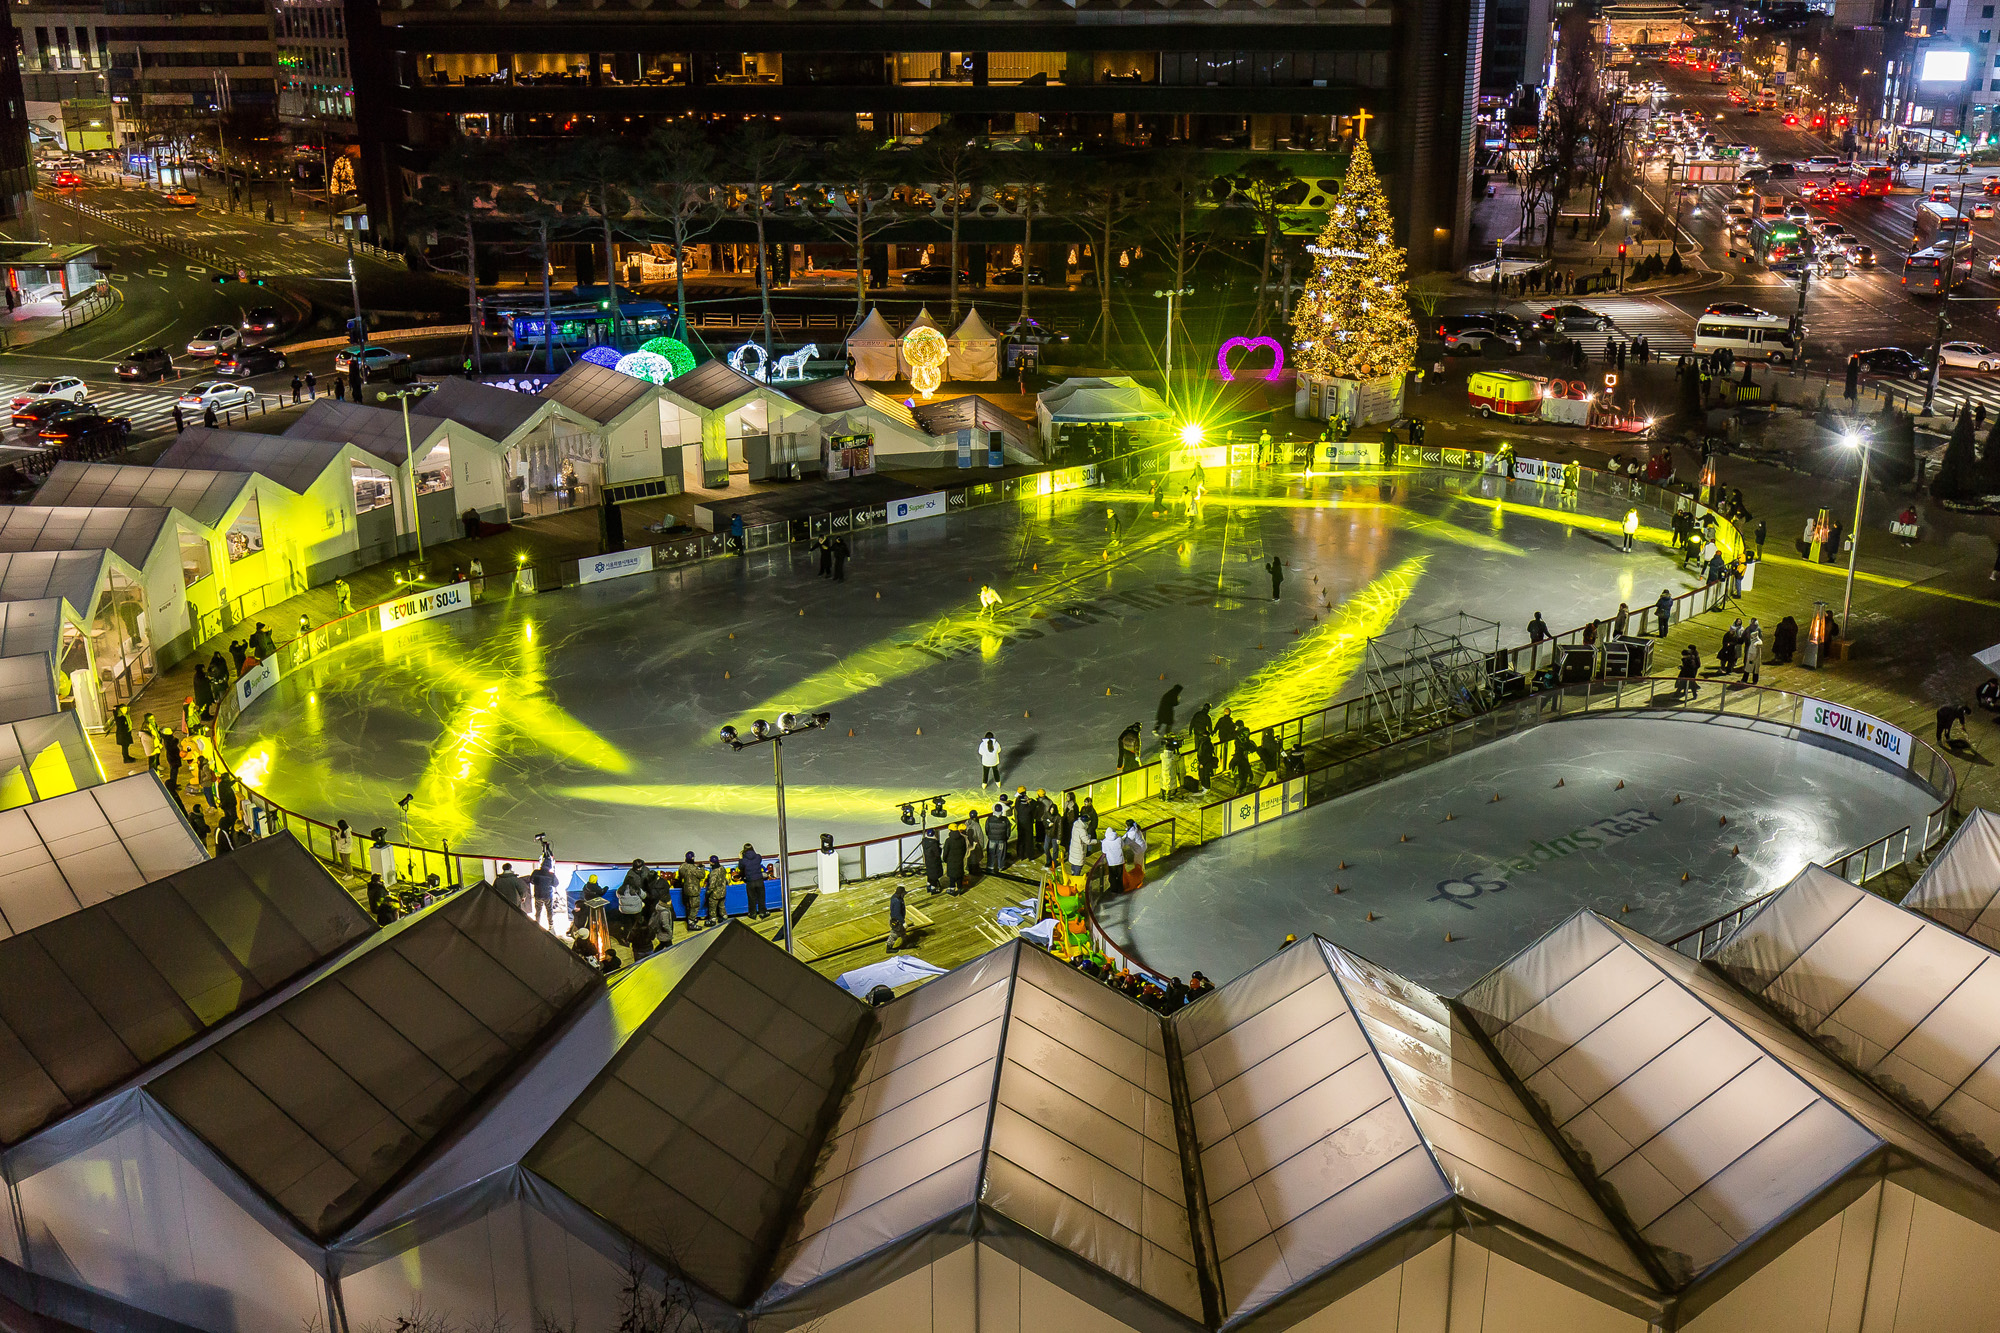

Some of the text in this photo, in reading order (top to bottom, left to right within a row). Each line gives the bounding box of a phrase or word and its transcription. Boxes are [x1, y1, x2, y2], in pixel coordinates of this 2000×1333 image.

[1306, 244, 1370, 259] Merry Christmas
[1514, 462, 1536, 475] EOUL
[908, 504, 926, 512] Super
[436, 590, 461, 608] SOUL
[1875, 728, 1901, 755] SOUL
[1496, 828, 1604, 880] Super
